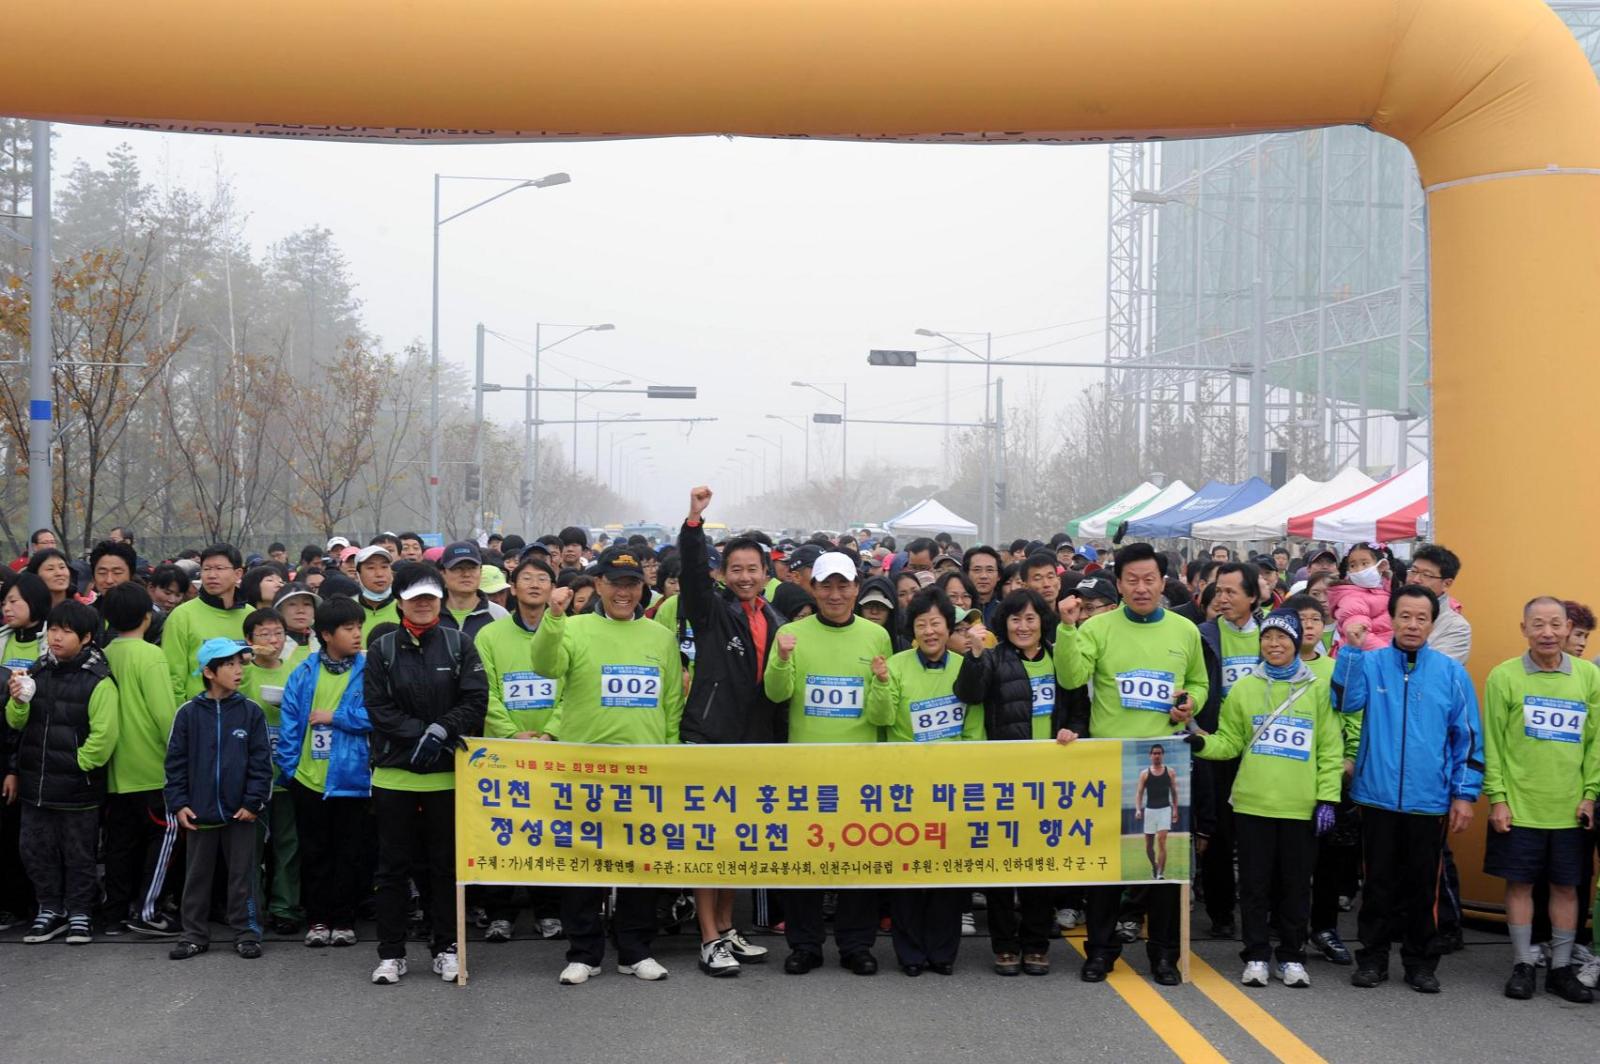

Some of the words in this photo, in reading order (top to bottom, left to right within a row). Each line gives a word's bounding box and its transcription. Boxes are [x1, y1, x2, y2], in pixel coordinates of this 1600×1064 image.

[509, 682, 553, 698] 213
[608, 678, 656, 695] 002
[811, 688, 857, 705] 001
[1121, 679, 1170, 700] 008
[918, 707, 964, 729] 828
[1531, 710, 1580, 730] 504
[478, 778, 530, 808] 인천
[552, 782, 663, 812] 건강걷기
[685, 785, 737, 812] 도시
[757, 785, 838, 814] 홍보를
[860, 784, 913, 813] 위한
[932, 781, 1106, 812] 바른걷기강사
[491, 817, 603, 849] 정성열의
[625, 823, 716, 851] 18일간
[735, 823, 788, 852] 인천
[807, 823, 947, 852] 3,000리
[970, 821, 1019, 849] 걷기
[1040, 819, 1093, 847] 행사
[684, 863, 713, 873] KACE
